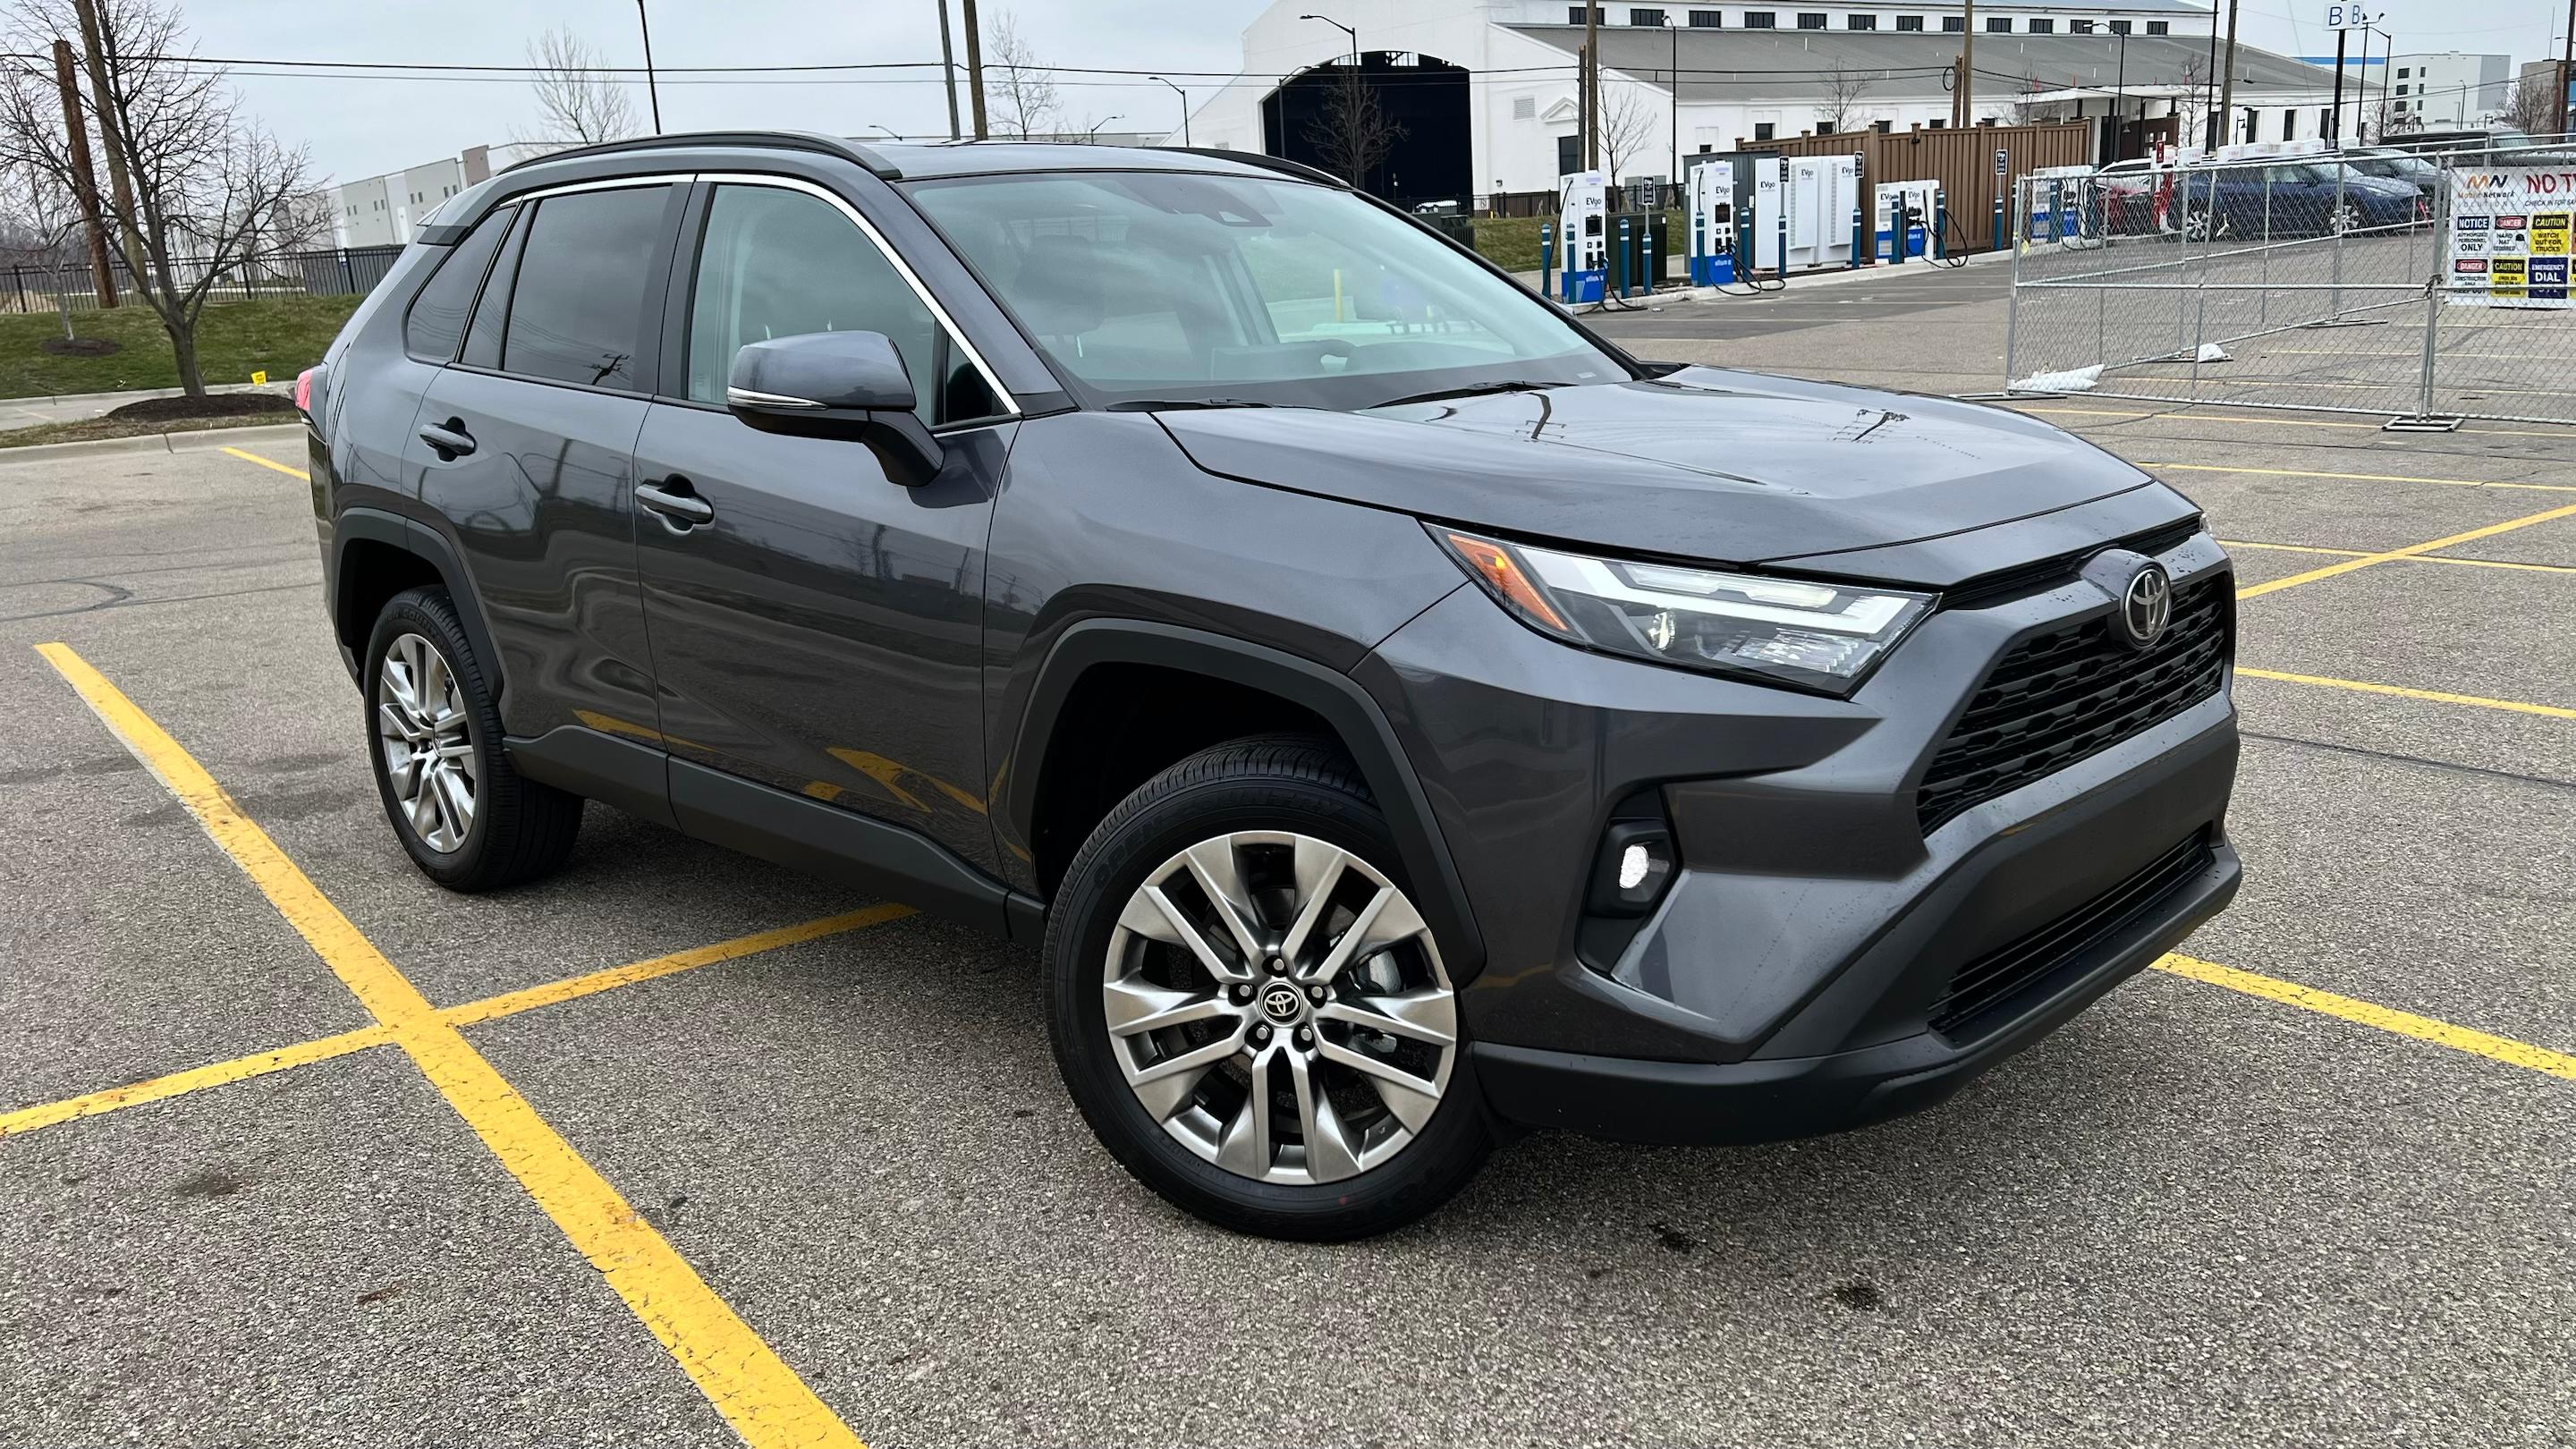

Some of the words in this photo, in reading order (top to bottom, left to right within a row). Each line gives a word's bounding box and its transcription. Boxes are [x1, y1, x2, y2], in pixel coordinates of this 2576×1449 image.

[2329, 6, 2343, 26] B
[2352, 5, 2360, 24] B
[1760, 181, 1776, 190] EVgo
[2526, 174, 2557, 193] NO
[2560, 174, 2576, 193] T
[1716, 186, 1731, 195] EVgo
[1586, 197, 1602, 207] EVgo
[2459, 218, 2487, 228] NOTICE
[2498, 218, 2521, 227] DANGER
[2535, 217, 2566, 227] CAUTION
[2495, 262, 2523, 271] CAUTION
[2535, 272, 2561, 282] DIAL
